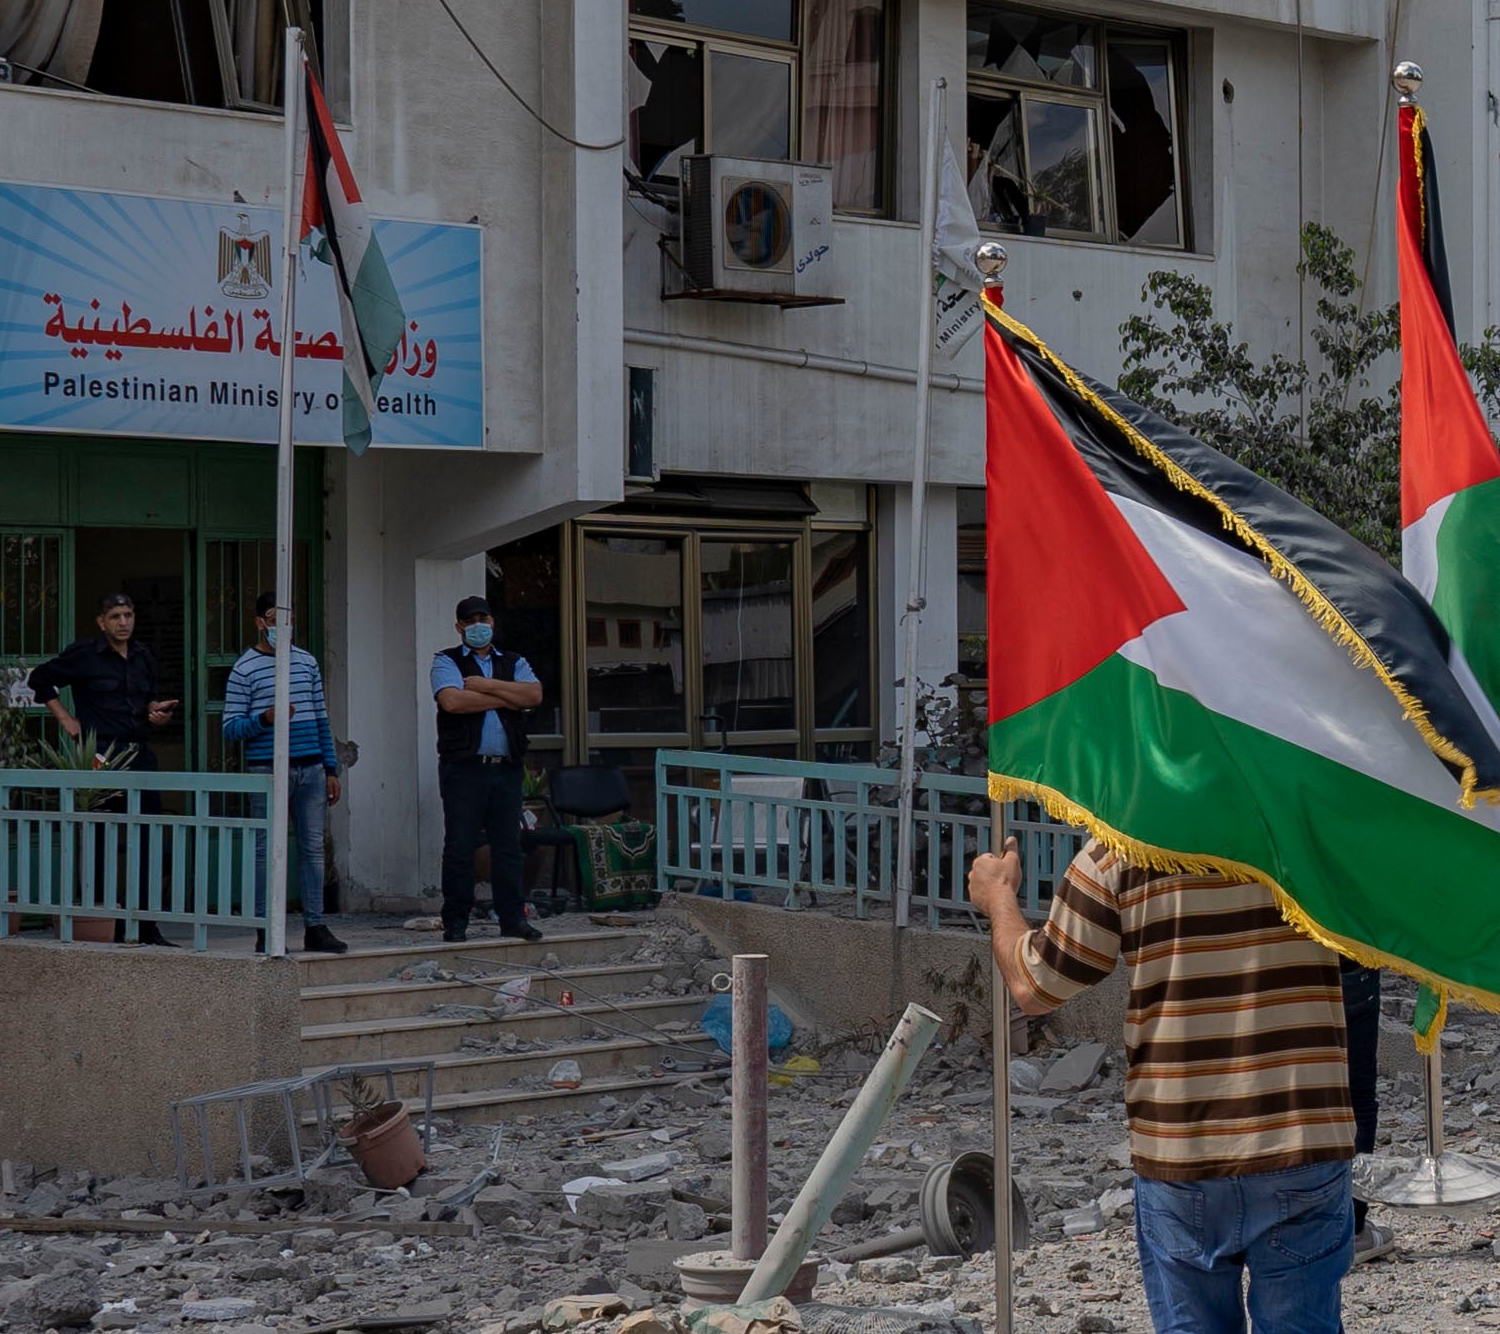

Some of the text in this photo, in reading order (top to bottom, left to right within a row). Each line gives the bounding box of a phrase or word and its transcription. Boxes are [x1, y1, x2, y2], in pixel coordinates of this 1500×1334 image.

[43, 292, 244, 361] الفلسطينية
[939, 300, 982, 344] Ministry
[385, 320, 438, 378] وزار
[43, 371, 437, 416] Palestinian Minisry o ealth
